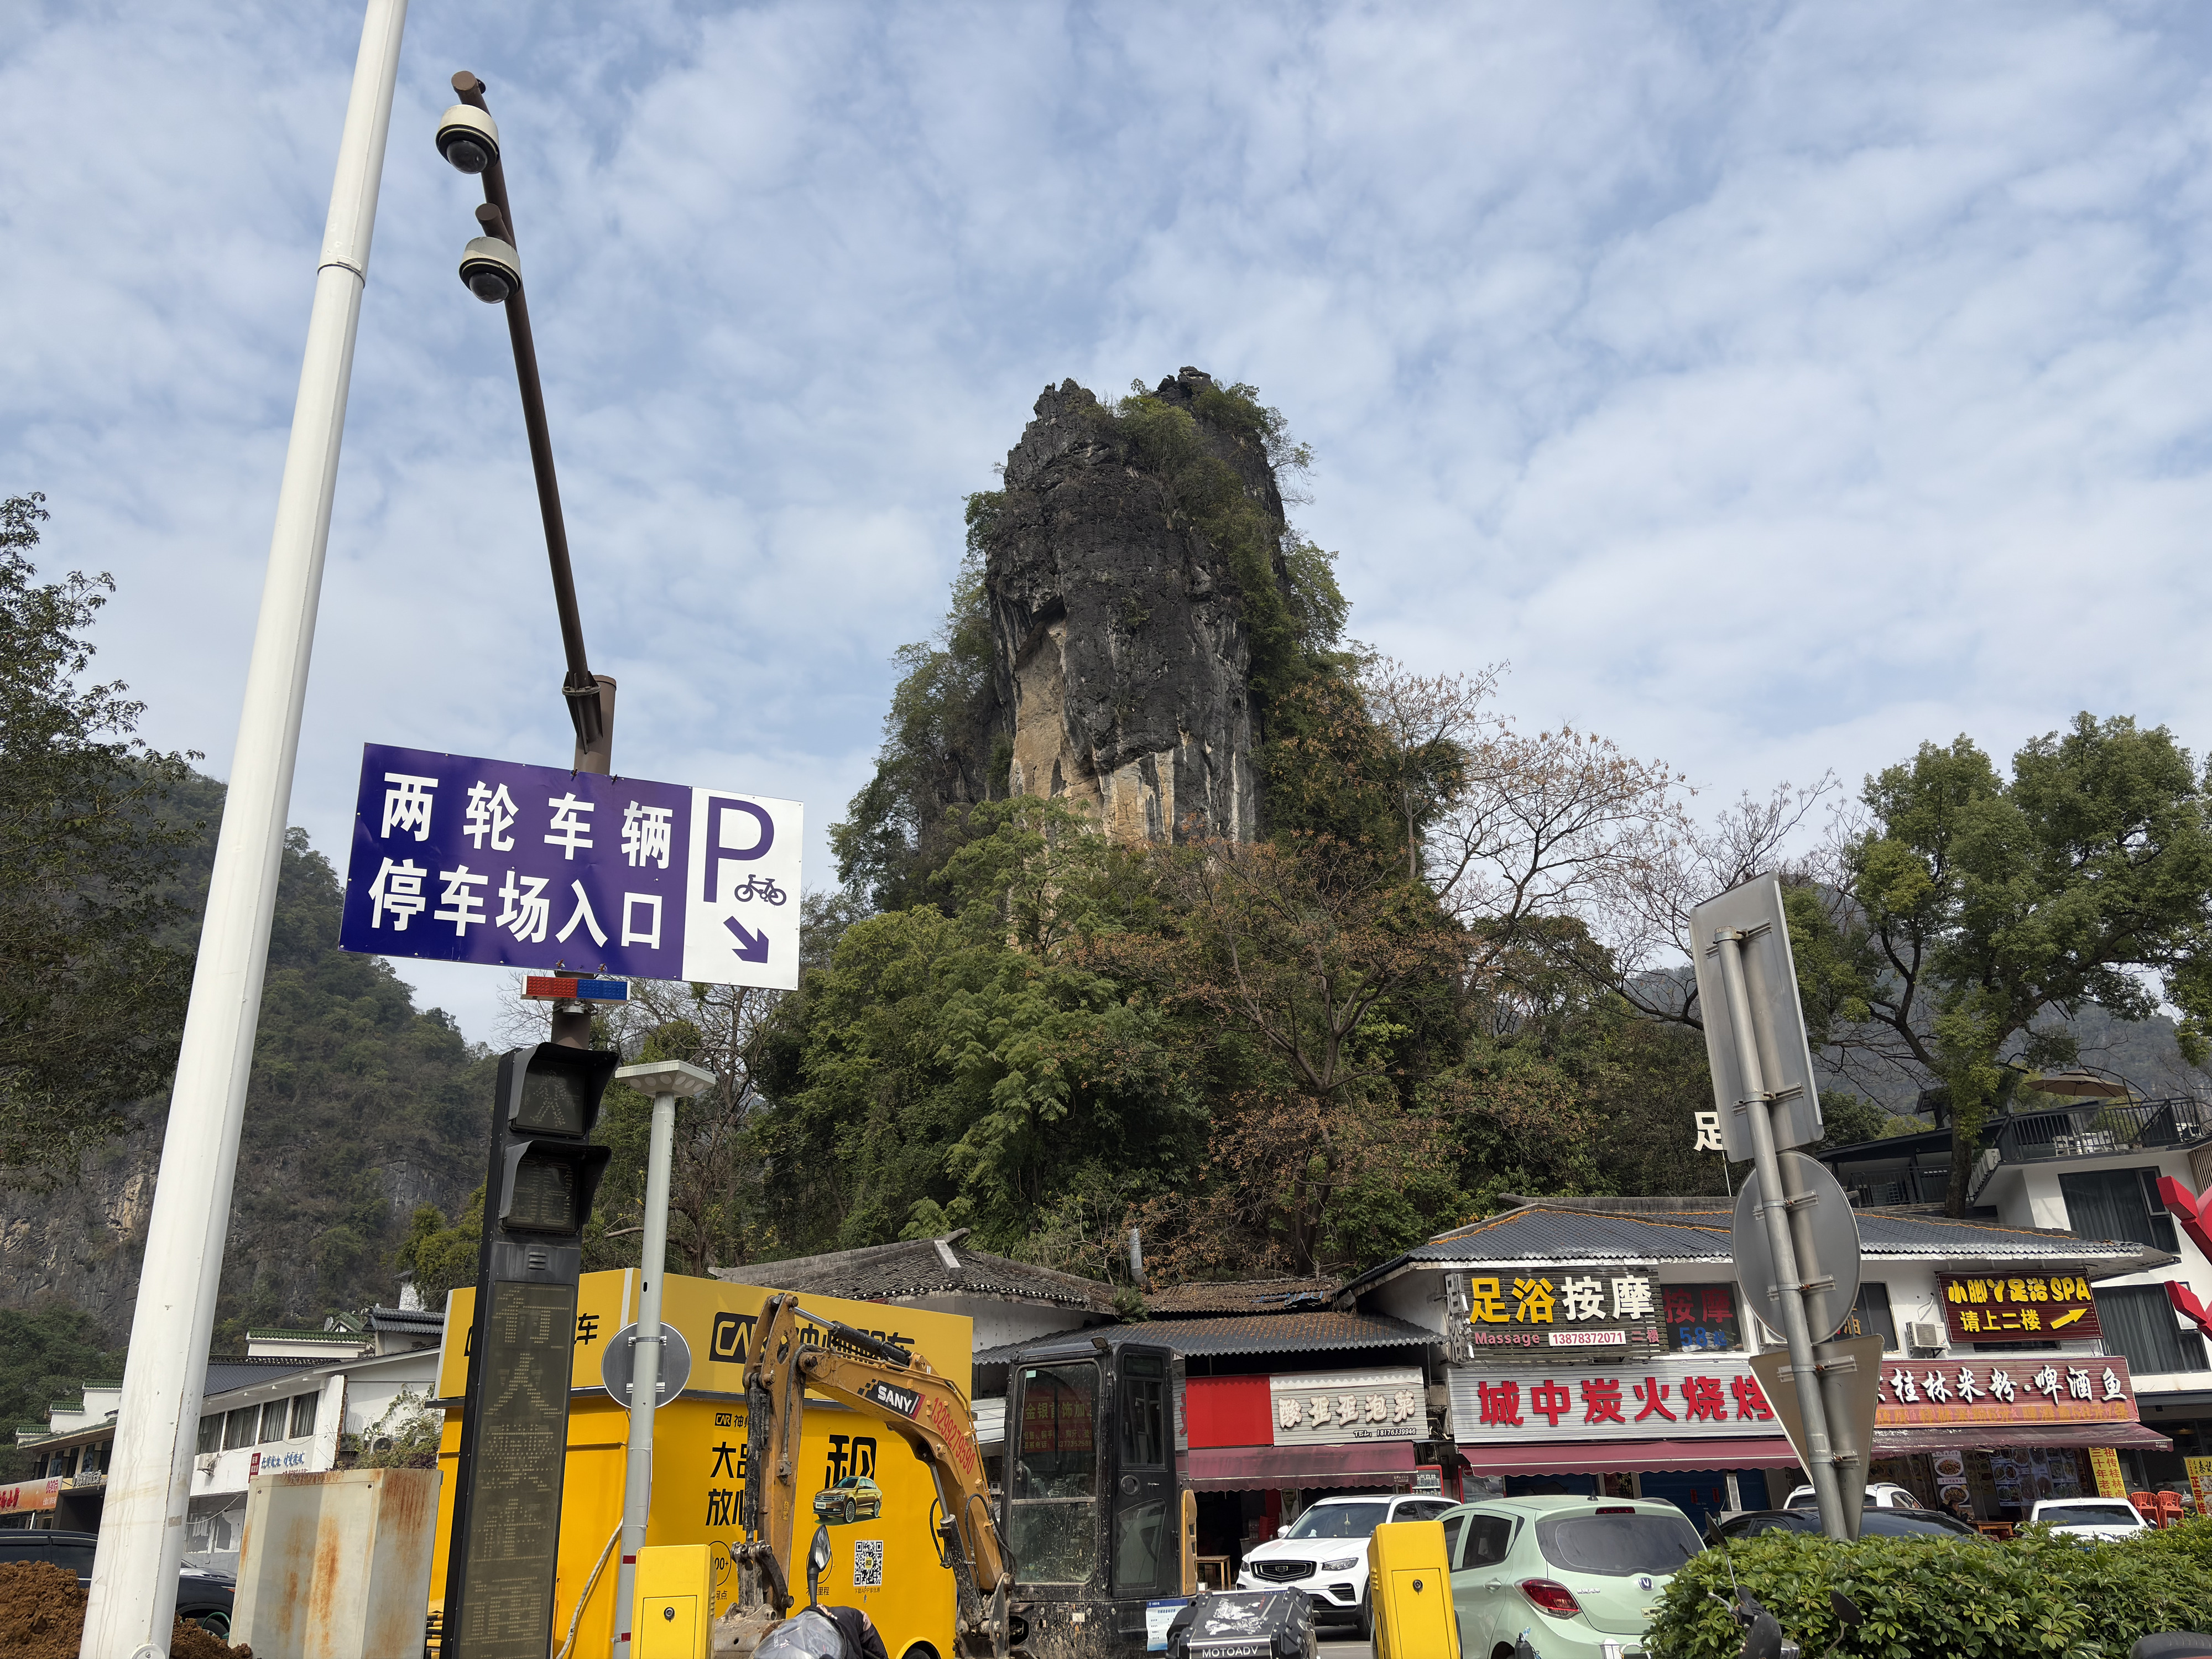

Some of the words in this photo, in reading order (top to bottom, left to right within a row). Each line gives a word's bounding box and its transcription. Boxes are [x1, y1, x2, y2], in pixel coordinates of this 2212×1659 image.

[380, 772, 673, 870] 两轮车辆
[703, 796, 775, 903] P
[369, 857, 663, 950] 停车场入口
[1469, 1275, 1655, 1324] 足浴按摩
[1663, 1287, 1734, 1324] 按摩
[1475, 1332, 1540, 1347] Massage
[1553, 1332, 1623, 1345] 13878372071
[1631, 1329, 1660, 1343] 二楼
[1960, 1309, 2041, 1332] 请上二楼
[878, 1385, 912, 1412] SANY
[1277, 1389, 1416, 1429] 酸歪歪泡菜
[1477, 1375, 1775, 1427] 城中炭火烧烤
[716, 1414, 731, 1426] CAR
[931, 1397, 976, 1475] 13299279590
[1377, 1428, 1416, 1437] 18176339946
[1202, 1646, 1259, 1658] MOTOADV
